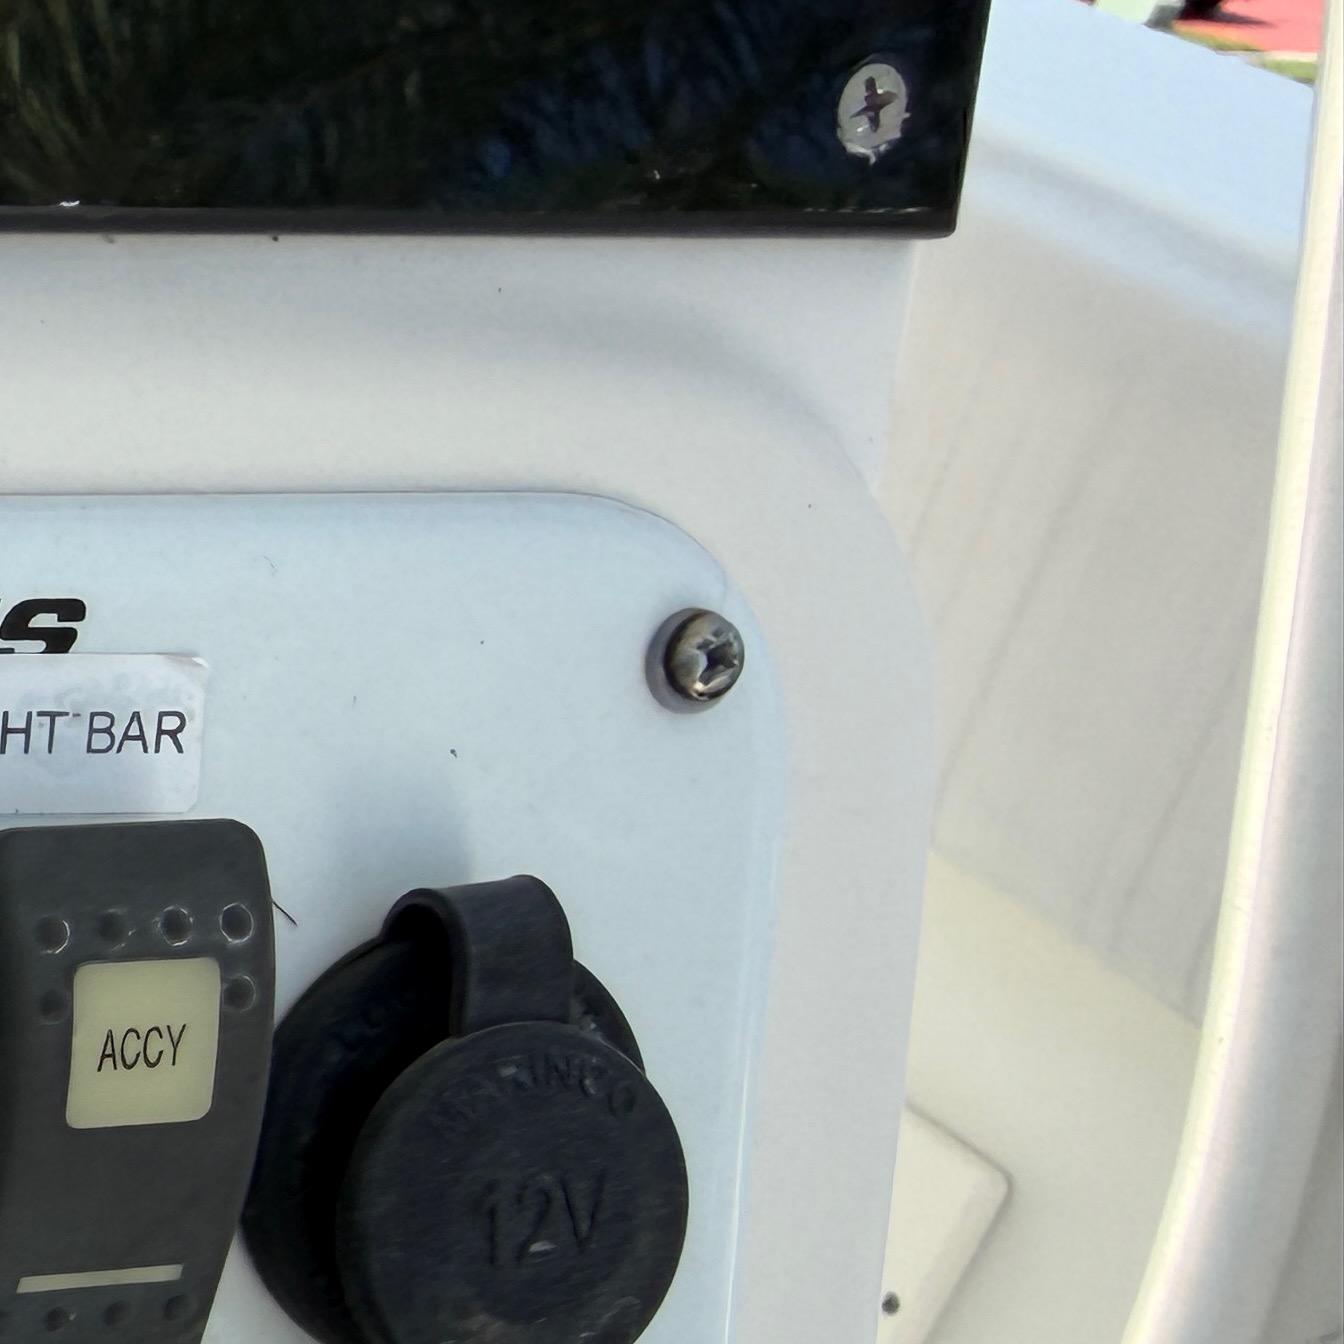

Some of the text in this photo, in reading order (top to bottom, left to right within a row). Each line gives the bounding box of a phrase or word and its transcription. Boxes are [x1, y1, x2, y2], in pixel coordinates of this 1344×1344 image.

[85, 710, 188, 755] BAR
[96, 1023, 187, 1073] ACCY
[478, 1168, 606, 1270] 12V
